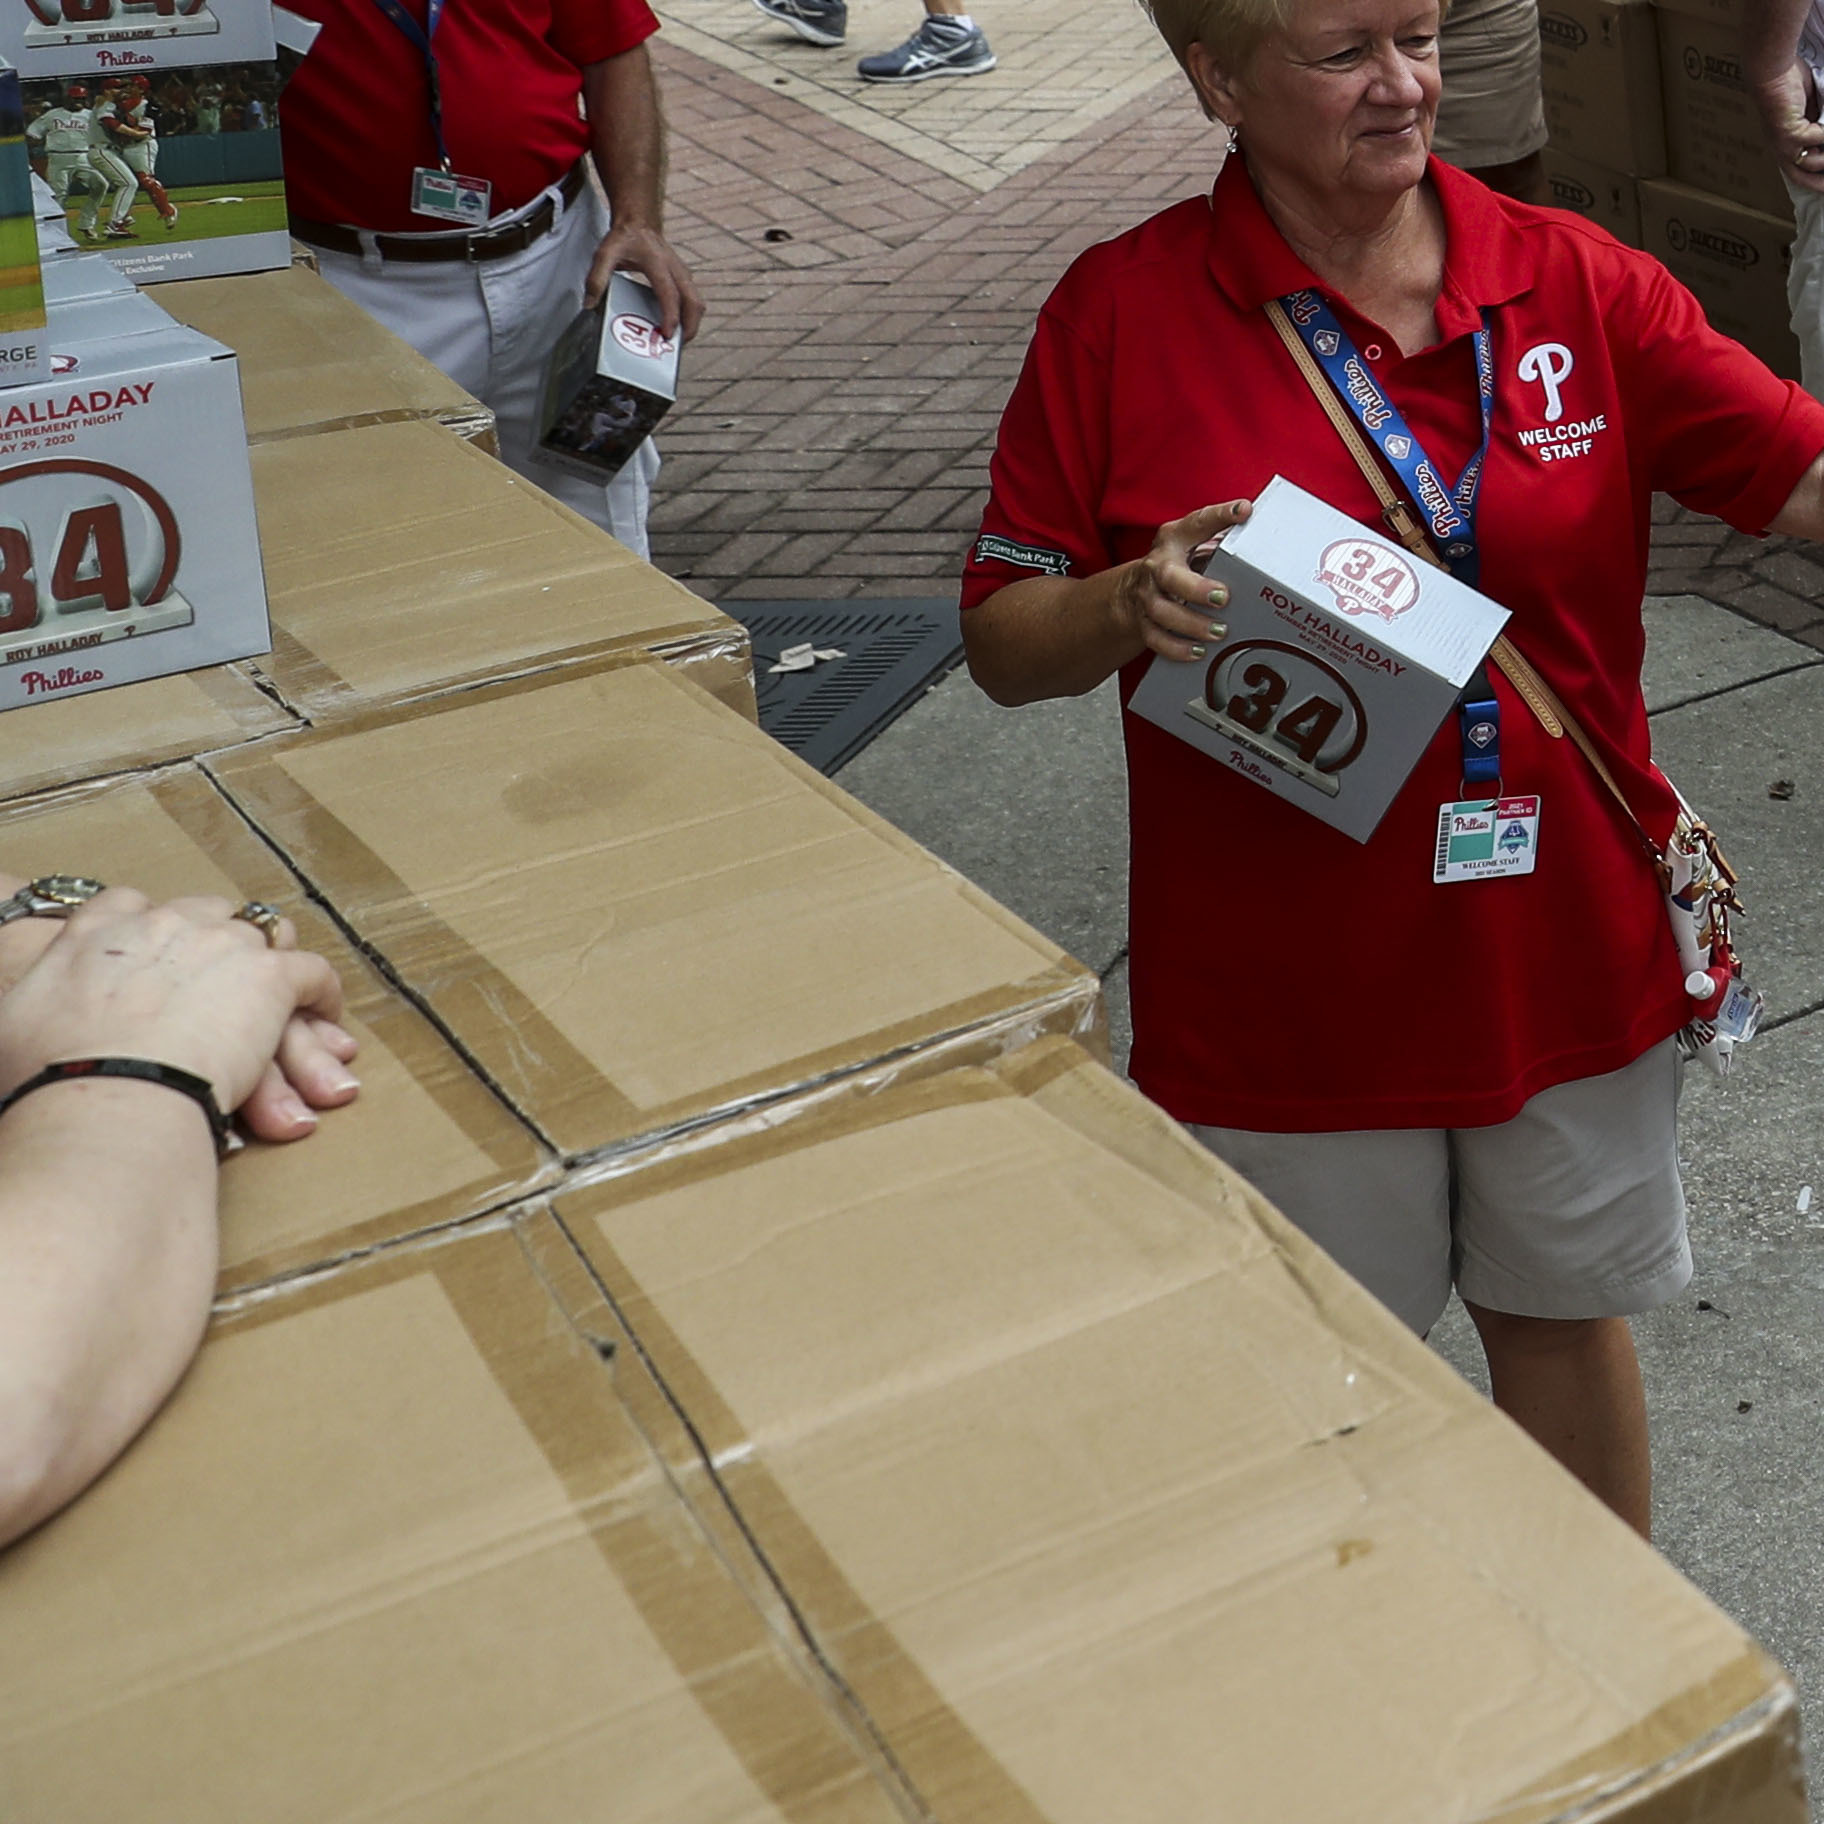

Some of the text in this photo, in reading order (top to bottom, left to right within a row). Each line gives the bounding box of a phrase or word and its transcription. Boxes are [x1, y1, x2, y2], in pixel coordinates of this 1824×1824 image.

[96, 50, 155, 67] Phillies
[125, 264, 166, 275] Exclusive
[147, 250, 194, 264] Bank Park
[620, 319, 649, 349] 34
[1344, 353, 1392, 432] Phillies
[1517, 342, 1575, 423] P
[82, 412, 124, 428] NIGHT
[1517, 415, 1608, 448] WELCOME
[21, 433, 76, 453] 29, 2020
[1538, 438, 1593, 462] STAFF
[1415, 459, 1461, 539] Phillies
[1012, 547, 1033, 563] Bank
[1033, 552, 1056, 566] Park
[1340, 547, 1406, 599] 34
[1259, 586, 1407, 677] ROY HALLADAY
[6, 632, 105, 664] ROY HALLADAY
[21, 666, 105, 696] Phillies
[1226, 662, 1344, 764] 34
[1229, 749, 1273, 786] Phillies
[1454, 816, 1489, 832] Phillies
[1462, 857, 1521, 870] WELCOME STAFF
